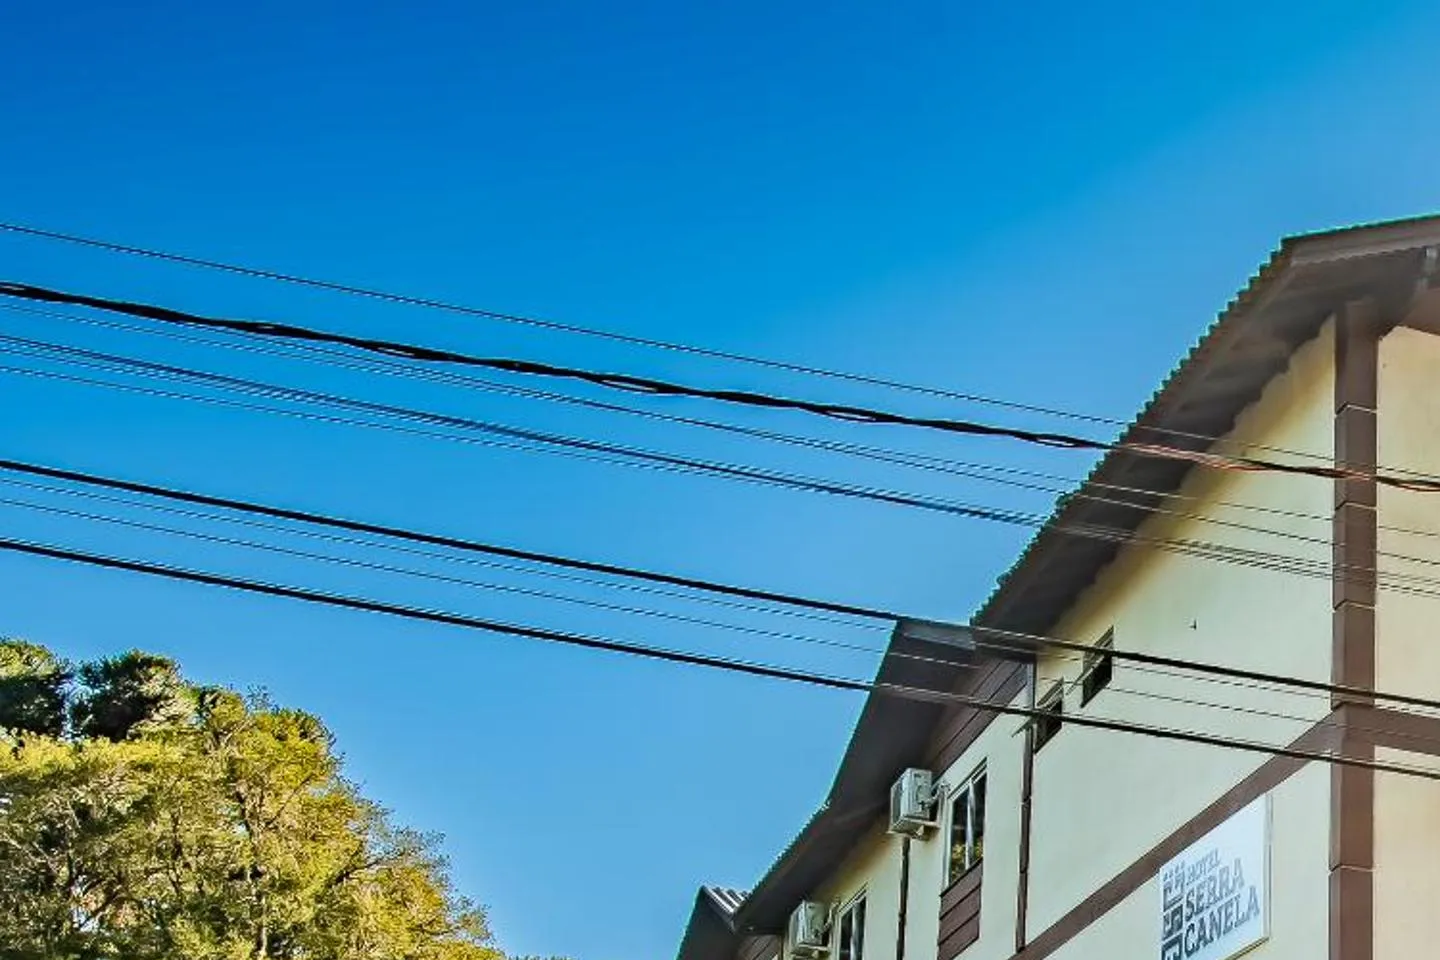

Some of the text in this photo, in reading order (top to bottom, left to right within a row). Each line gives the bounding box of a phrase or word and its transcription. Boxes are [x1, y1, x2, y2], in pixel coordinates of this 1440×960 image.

[1185, 858, 1245, 922] SERRA
[1187, 849, 1222, 884] HOTEL
[1184, 885, 1260, 958] CANELA
